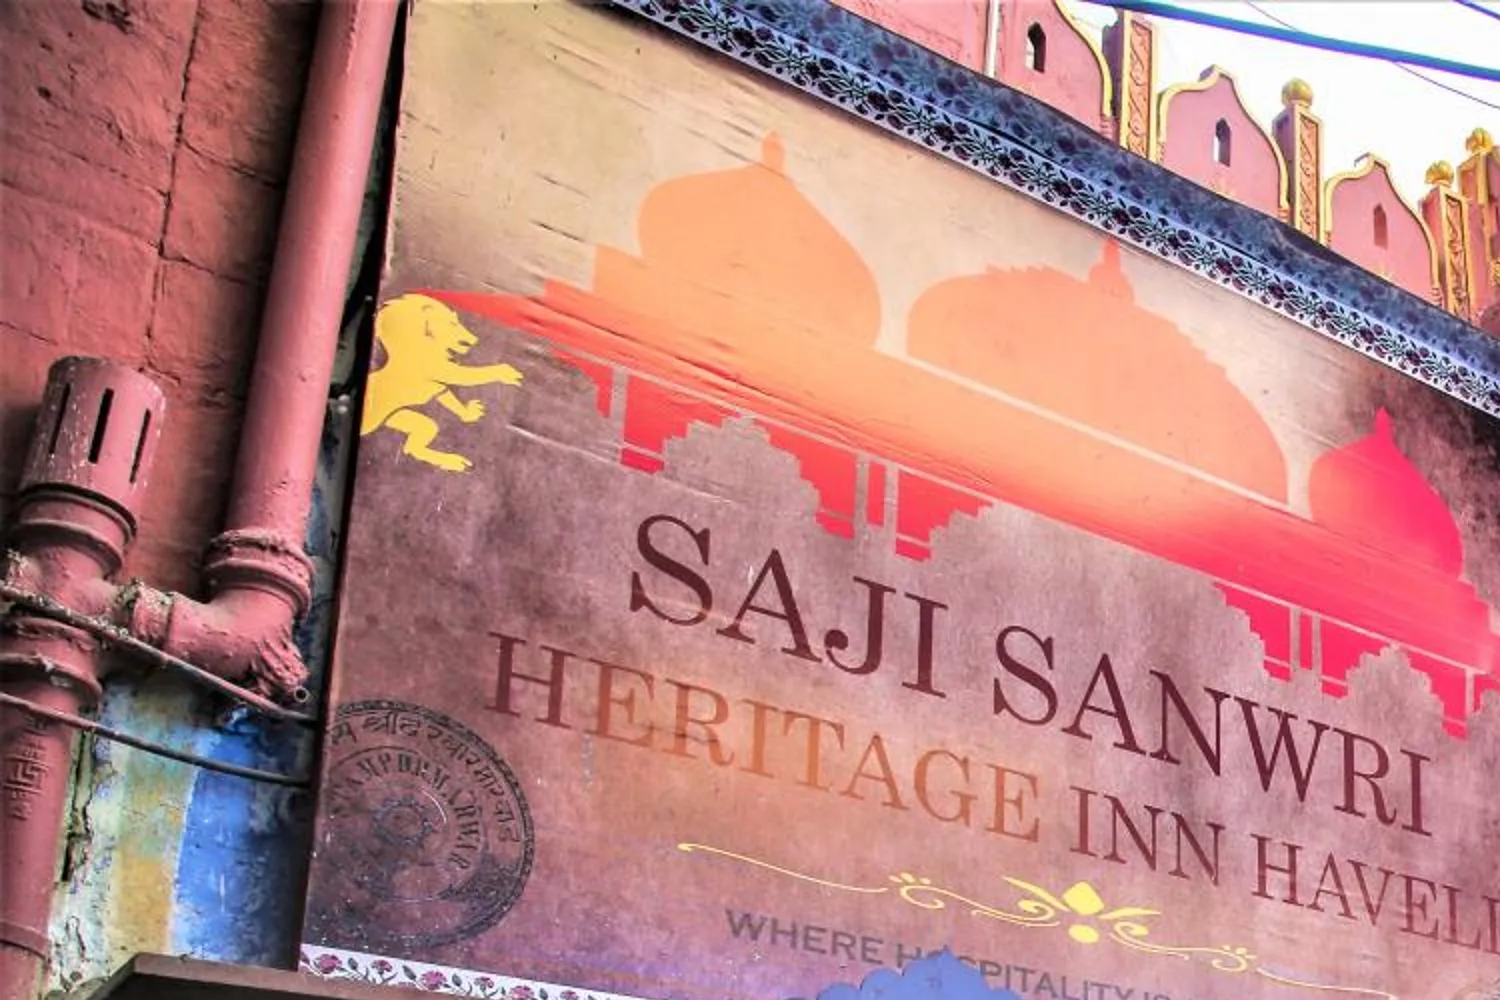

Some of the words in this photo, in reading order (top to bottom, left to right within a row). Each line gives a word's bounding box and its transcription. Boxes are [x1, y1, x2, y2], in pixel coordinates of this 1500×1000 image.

[485, 631, 1041, 843] HERITAGE
[1069, 785, 1226, 887] INN
[629, 514, 948, 699] SAJI
[992, 625, 1432, 837] SANWRI
[725, 908, 884, 966] WHERE
